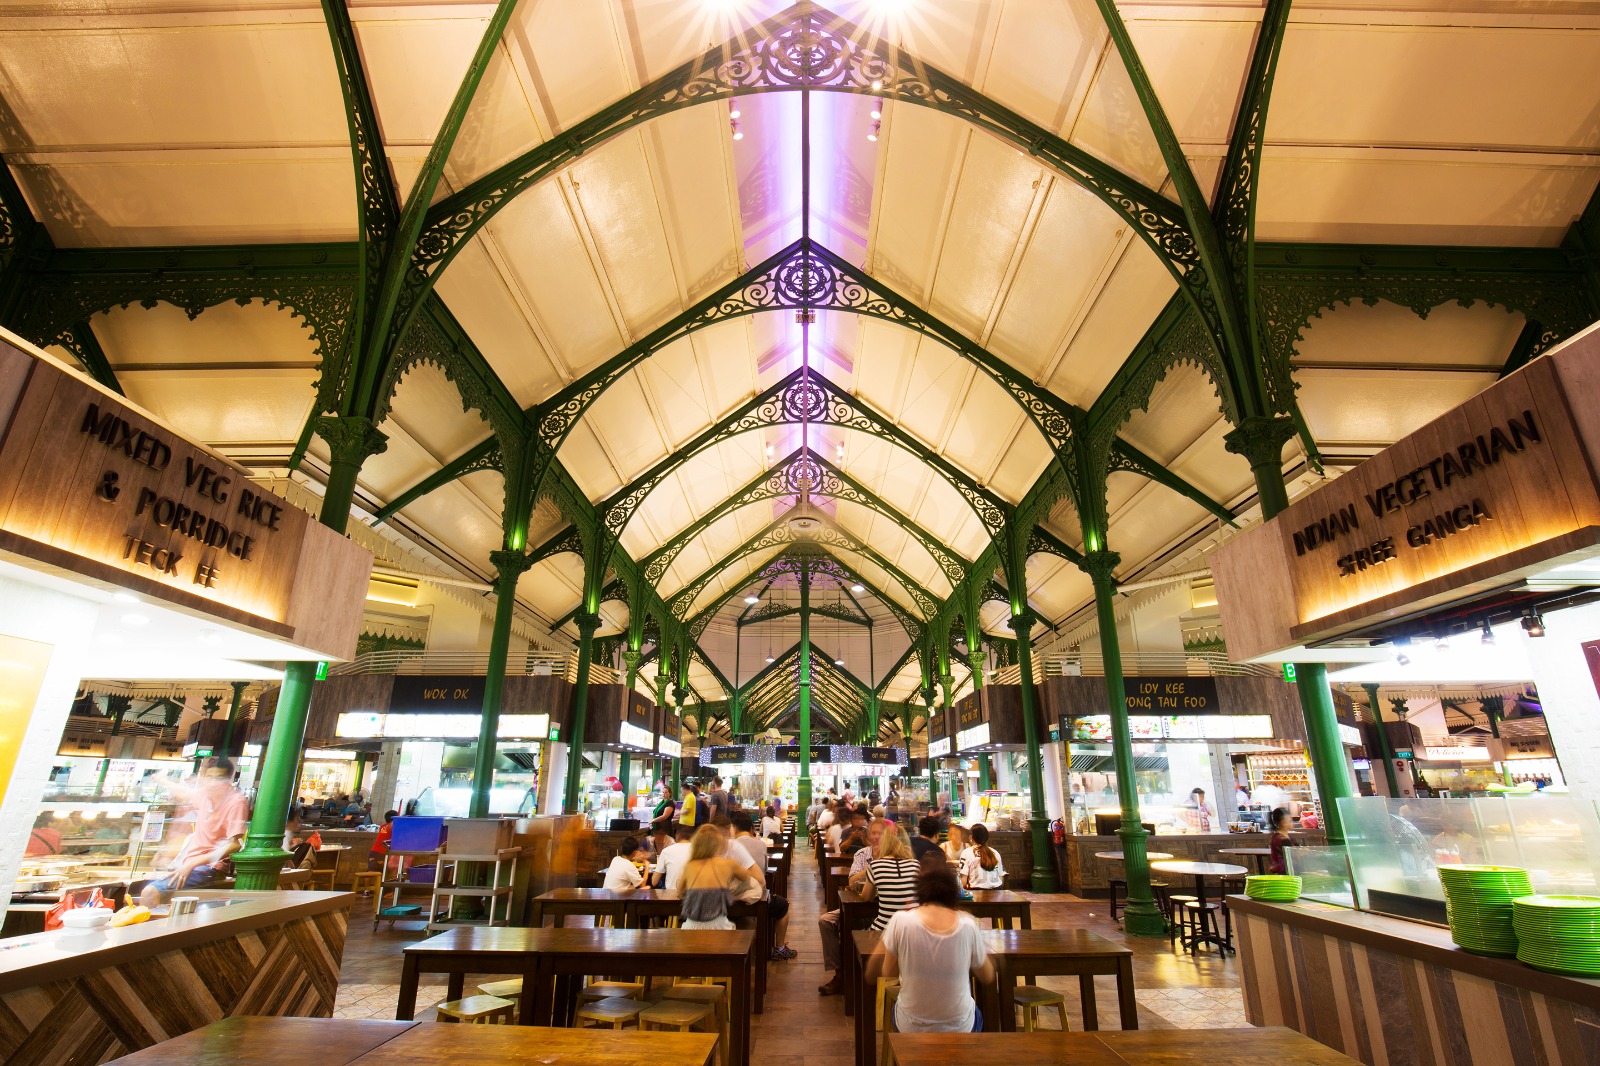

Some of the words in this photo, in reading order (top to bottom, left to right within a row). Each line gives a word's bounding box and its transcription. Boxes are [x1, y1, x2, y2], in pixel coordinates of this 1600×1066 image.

[81, 403, 171, 471] MIXED
[185, 457, 231, 504] VEG
[238, 488, 283, 532] RICE
[1292, 503, 1359, 556] INDIAN
[1365, 410, 1541, 520] VEGETARIAN
[97, 470, 120, 504] &
[135, 487, 255, 562] PORRIDGE
[1337, 536, 1397, 577] SHREE
[1406, 498, 1493, 549] GANGA
[123, 534, 184, 577] TECK
[193, 562, 220, 589] EE
[316, 661, 325, 676] IT
[424, 688, 448, 700] WOK
[453, 688, 470, 700] OK
[1139, 683, 1159, 694] LOY
[1165, 682, 1185, 694] KEE
[1158, 697, 1177, 708] TAU
[1184, 697, 1207, 708] FOO
